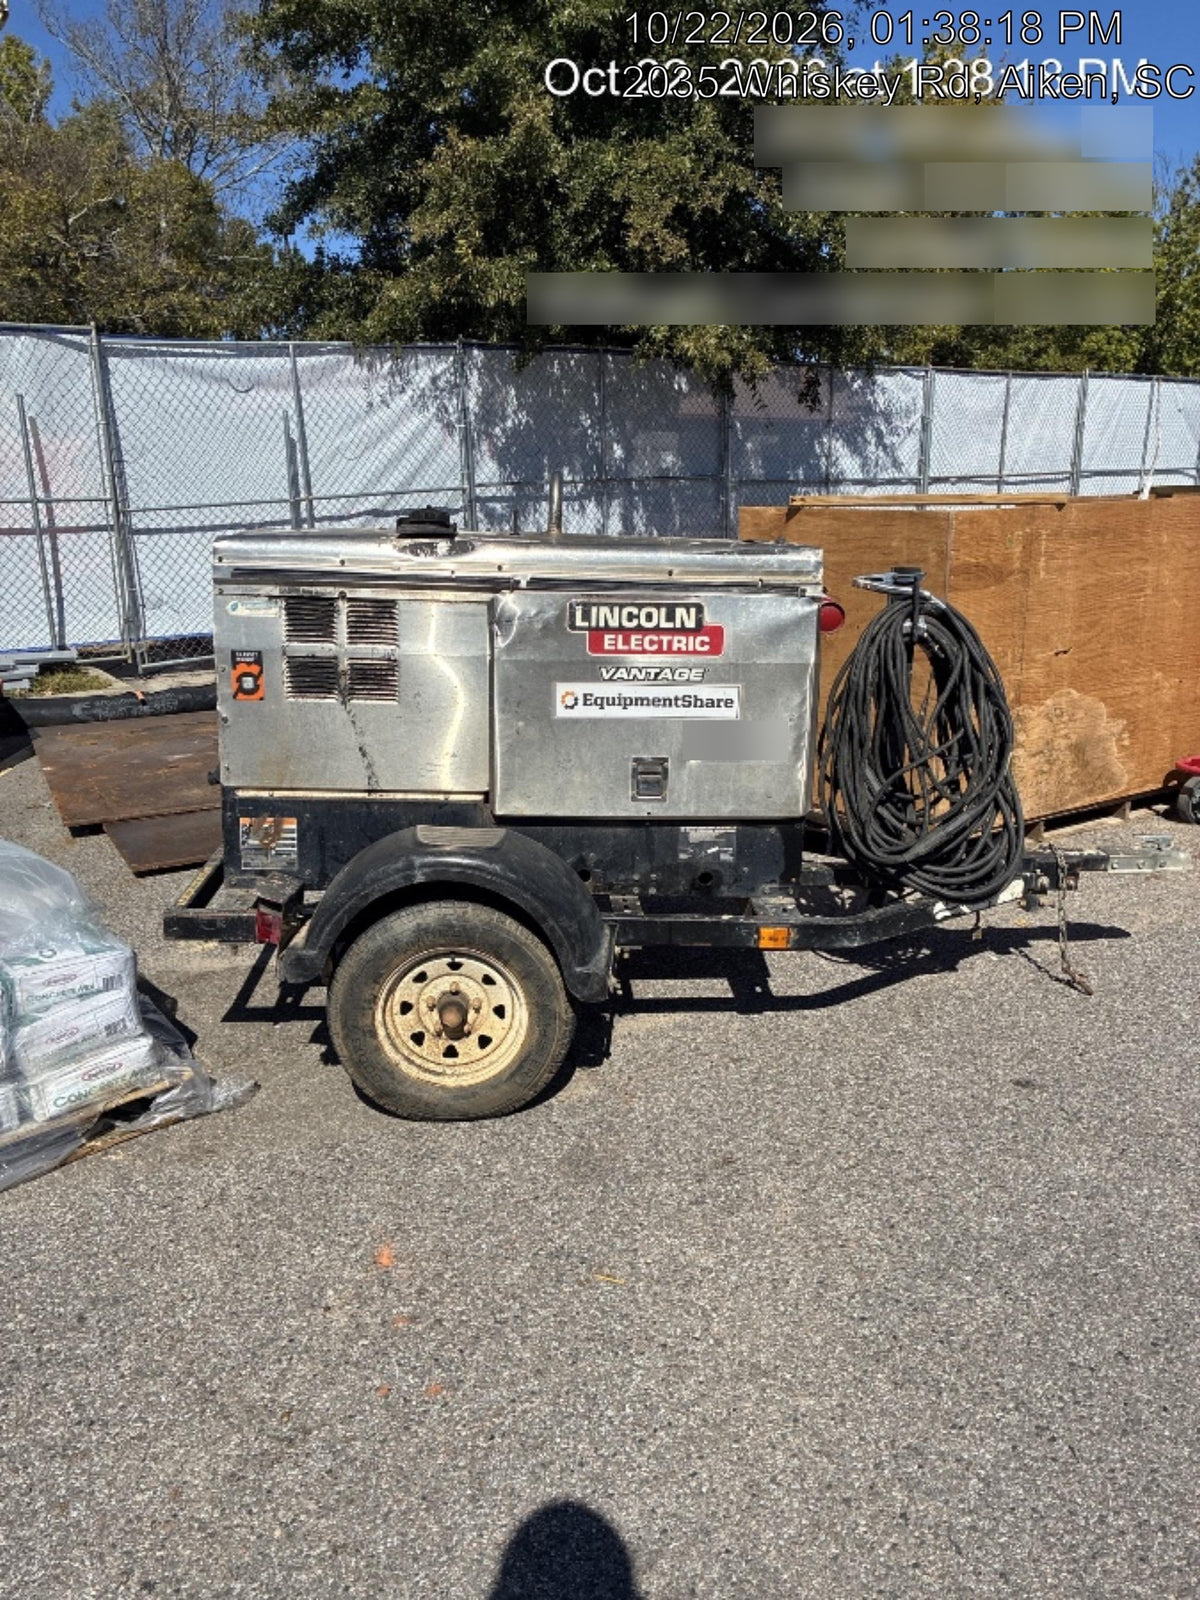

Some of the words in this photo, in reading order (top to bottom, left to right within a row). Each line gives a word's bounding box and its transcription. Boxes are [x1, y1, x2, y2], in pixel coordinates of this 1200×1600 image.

[574, 605, 697, 629] LINCOLN
[603, 634, 711, 652] ELECTRIC
[599, 666, 705, 682] VANTAGE
[582, 692, 734, 710] EquipmentShare
